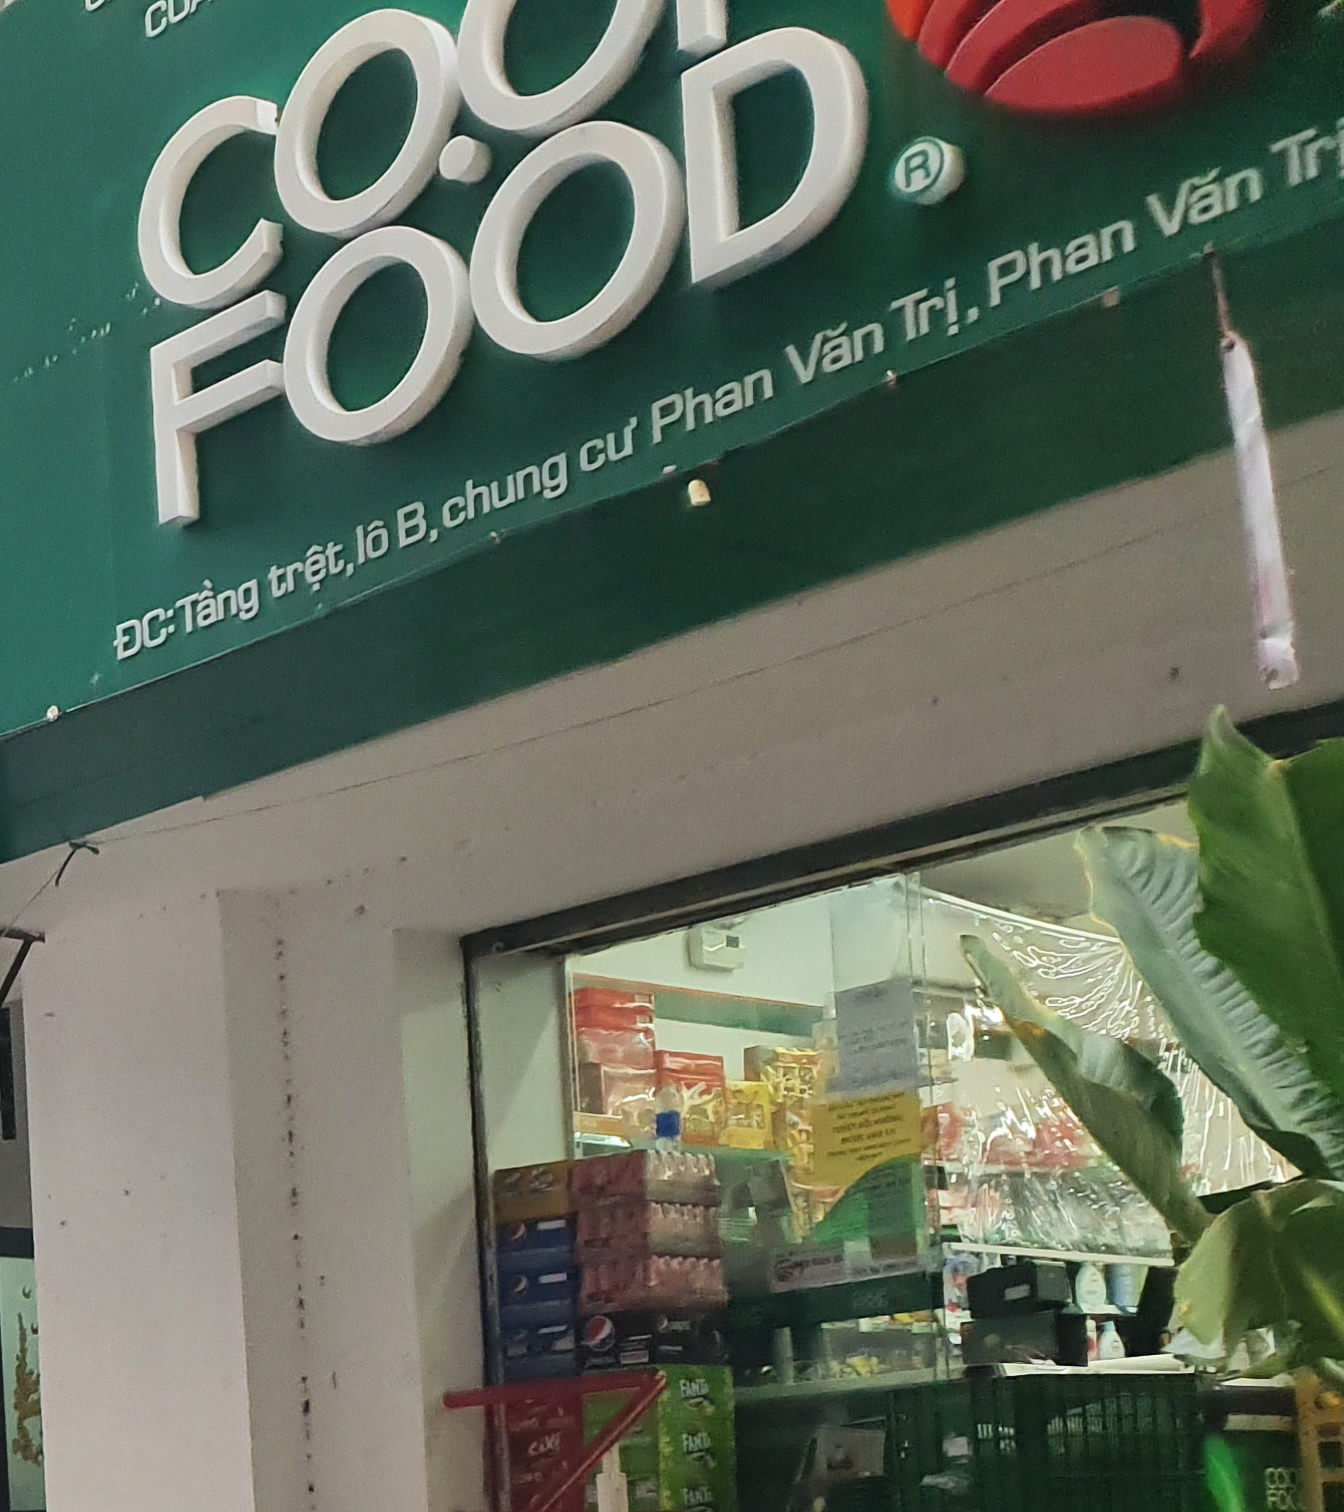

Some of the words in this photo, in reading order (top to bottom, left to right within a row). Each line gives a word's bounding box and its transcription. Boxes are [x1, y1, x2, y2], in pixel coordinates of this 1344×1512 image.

[150, 27, 868, 526] FOOD
[651, 367, 773, 444] Phan
[784, 320, 884, 384] Văn
[890, 276, 980, 337] Trị,
[986, 218, 1138, 307] Phan
[1144, 166, 1265, 238] Văn
